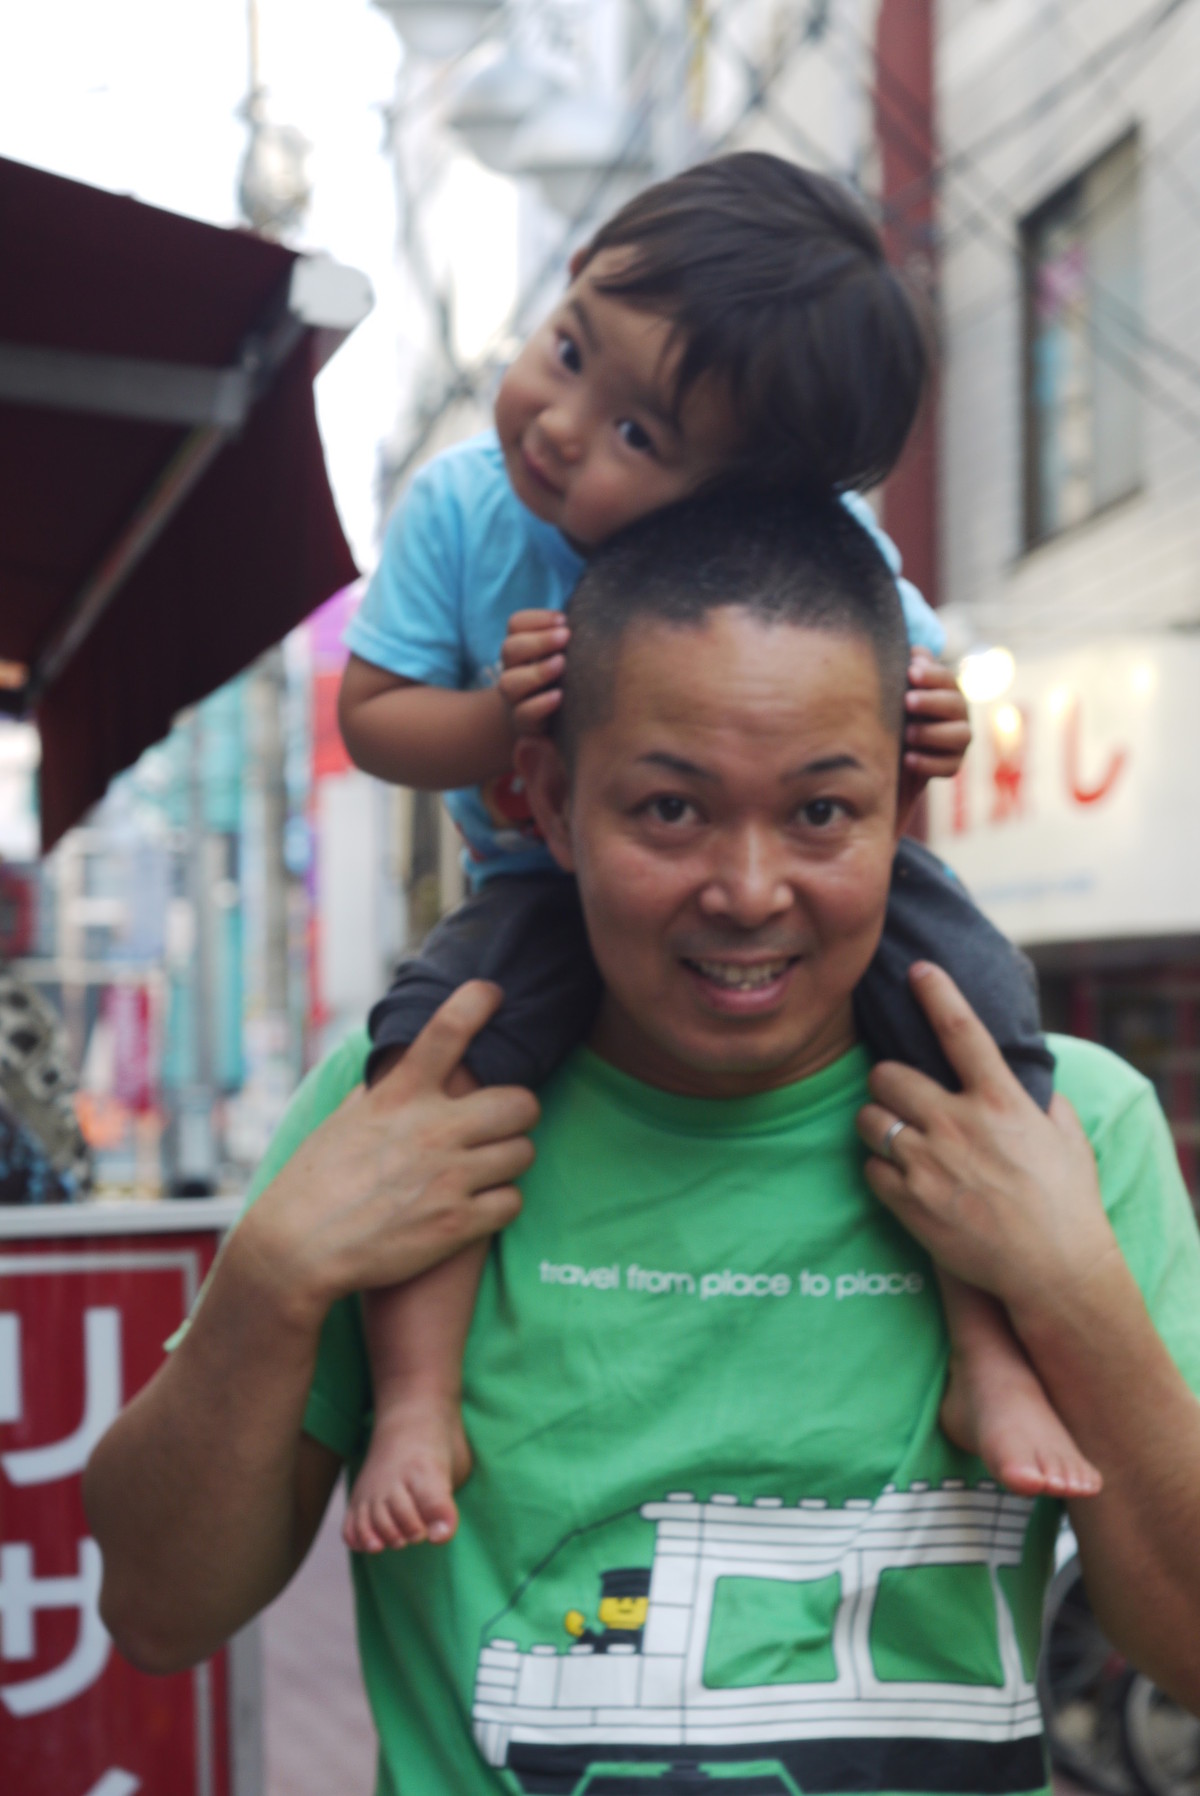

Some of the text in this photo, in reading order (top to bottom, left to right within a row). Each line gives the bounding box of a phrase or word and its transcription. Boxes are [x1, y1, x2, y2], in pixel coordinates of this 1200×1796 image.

[540, 1260, 923, 1300] travel from place to place
